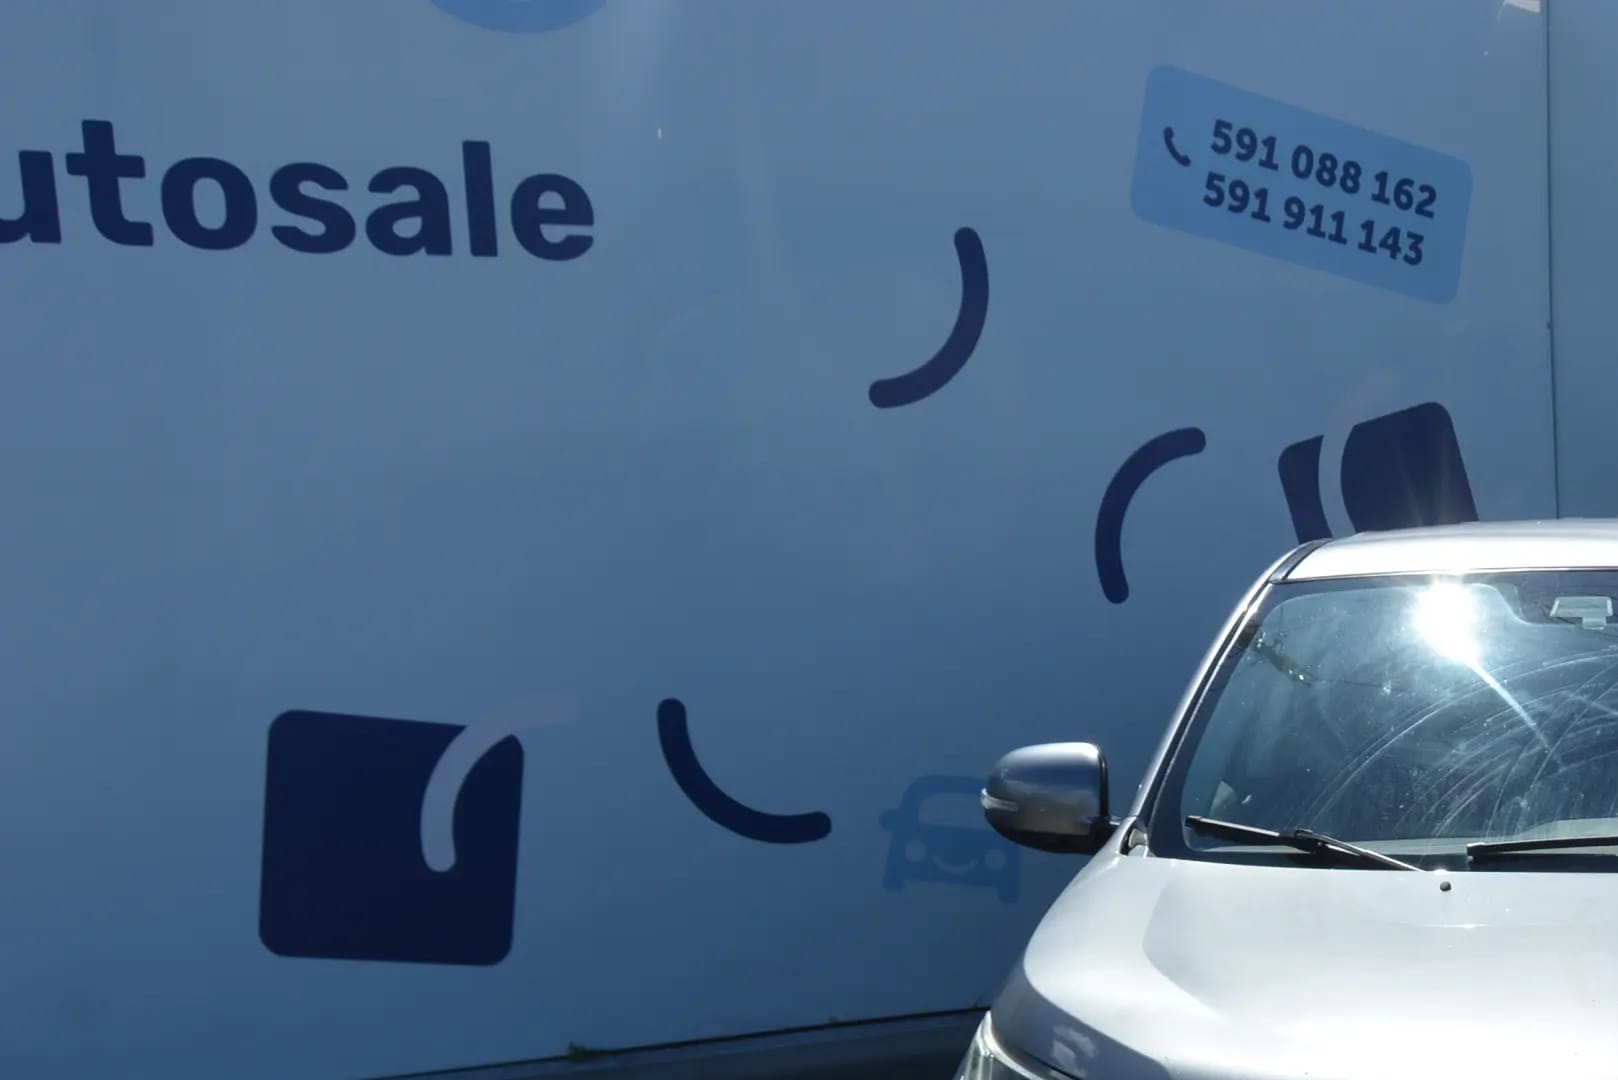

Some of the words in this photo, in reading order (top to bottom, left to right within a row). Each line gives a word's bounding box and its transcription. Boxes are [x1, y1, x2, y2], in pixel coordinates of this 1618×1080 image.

[1202, 170, 1272, 224] 591
[1281, 195, 1349, 246] 911
[1356, 218, 1425, 267] 143
[1210, 118, 1280, 172] 591
[1290, 144, 1363, 196] 088
[1370, 170, 1438, 220] 162
